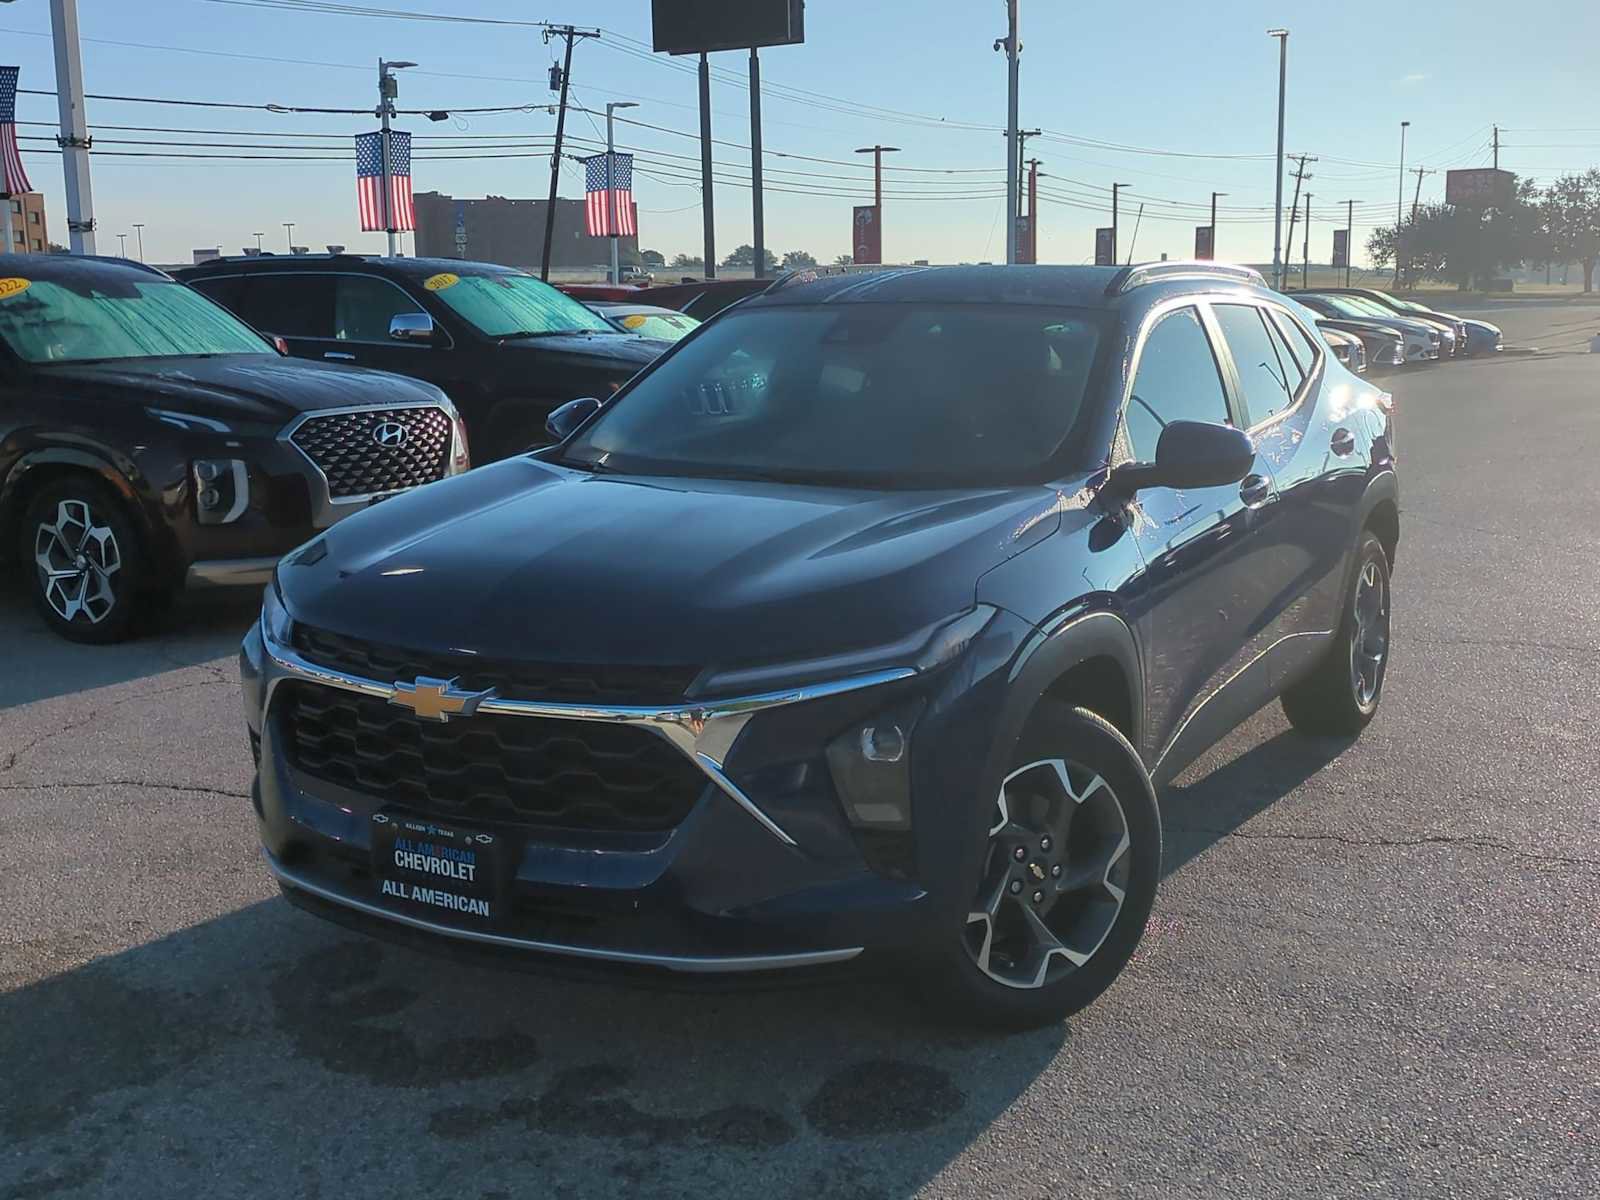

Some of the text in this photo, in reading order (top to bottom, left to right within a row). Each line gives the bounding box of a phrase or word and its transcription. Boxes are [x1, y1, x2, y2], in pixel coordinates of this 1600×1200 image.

[395, 838, 475, 865] ALL AMERICAN
[395, 850, 475, 881] CHEVROLET
[382, 880, 490, 917] ALL AMERICAN
